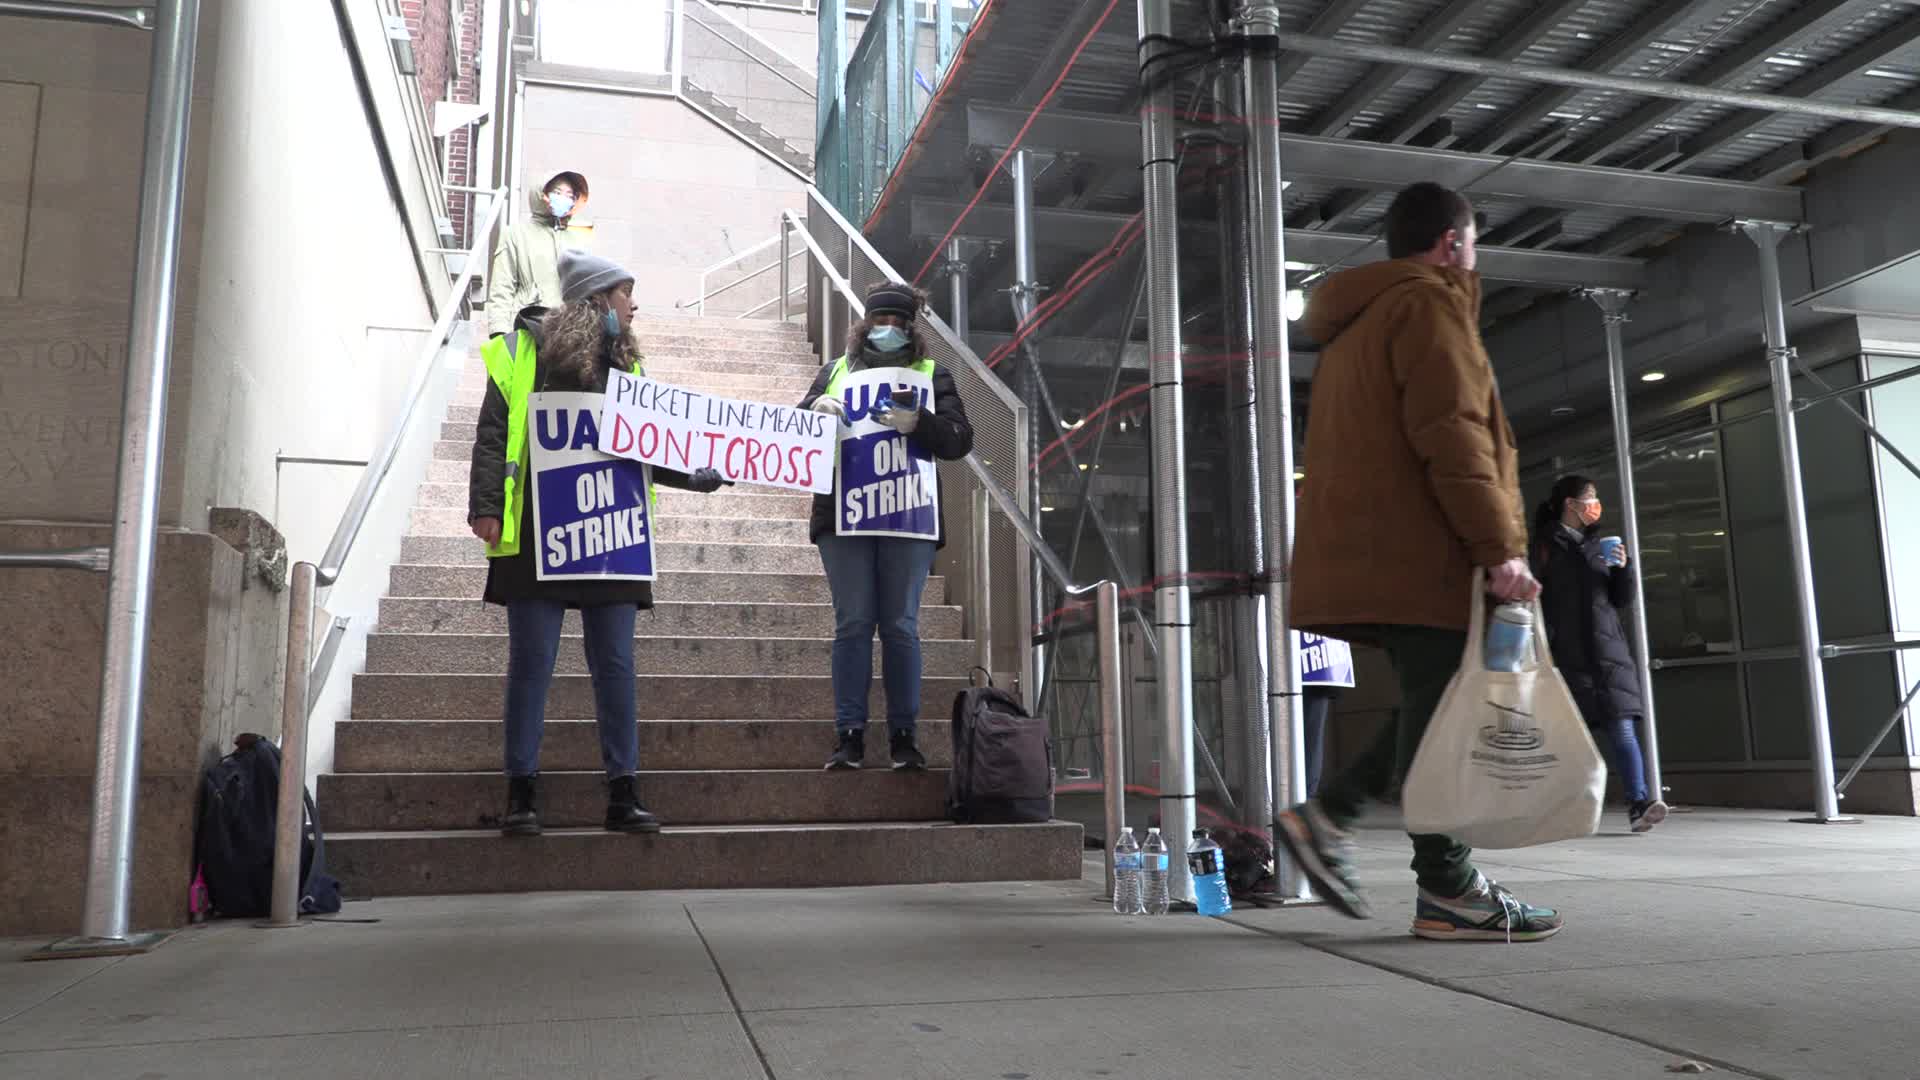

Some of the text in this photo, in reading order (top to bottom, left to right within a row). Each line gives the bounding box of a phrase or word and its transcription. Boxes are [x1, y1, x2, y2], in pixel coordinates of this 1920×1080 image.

[535, 408, 603, 451] UA
[616, 375, 827, 438] PICKET LINE MEANS
[611, 412, 823, 488] DON'T CROSS
[873, 436, 908, 477] ON
[575, 467, 616, 514] ON
[845, 473, 932, 525] STRIKE
[546, 504, 647, 568] STRIKE
